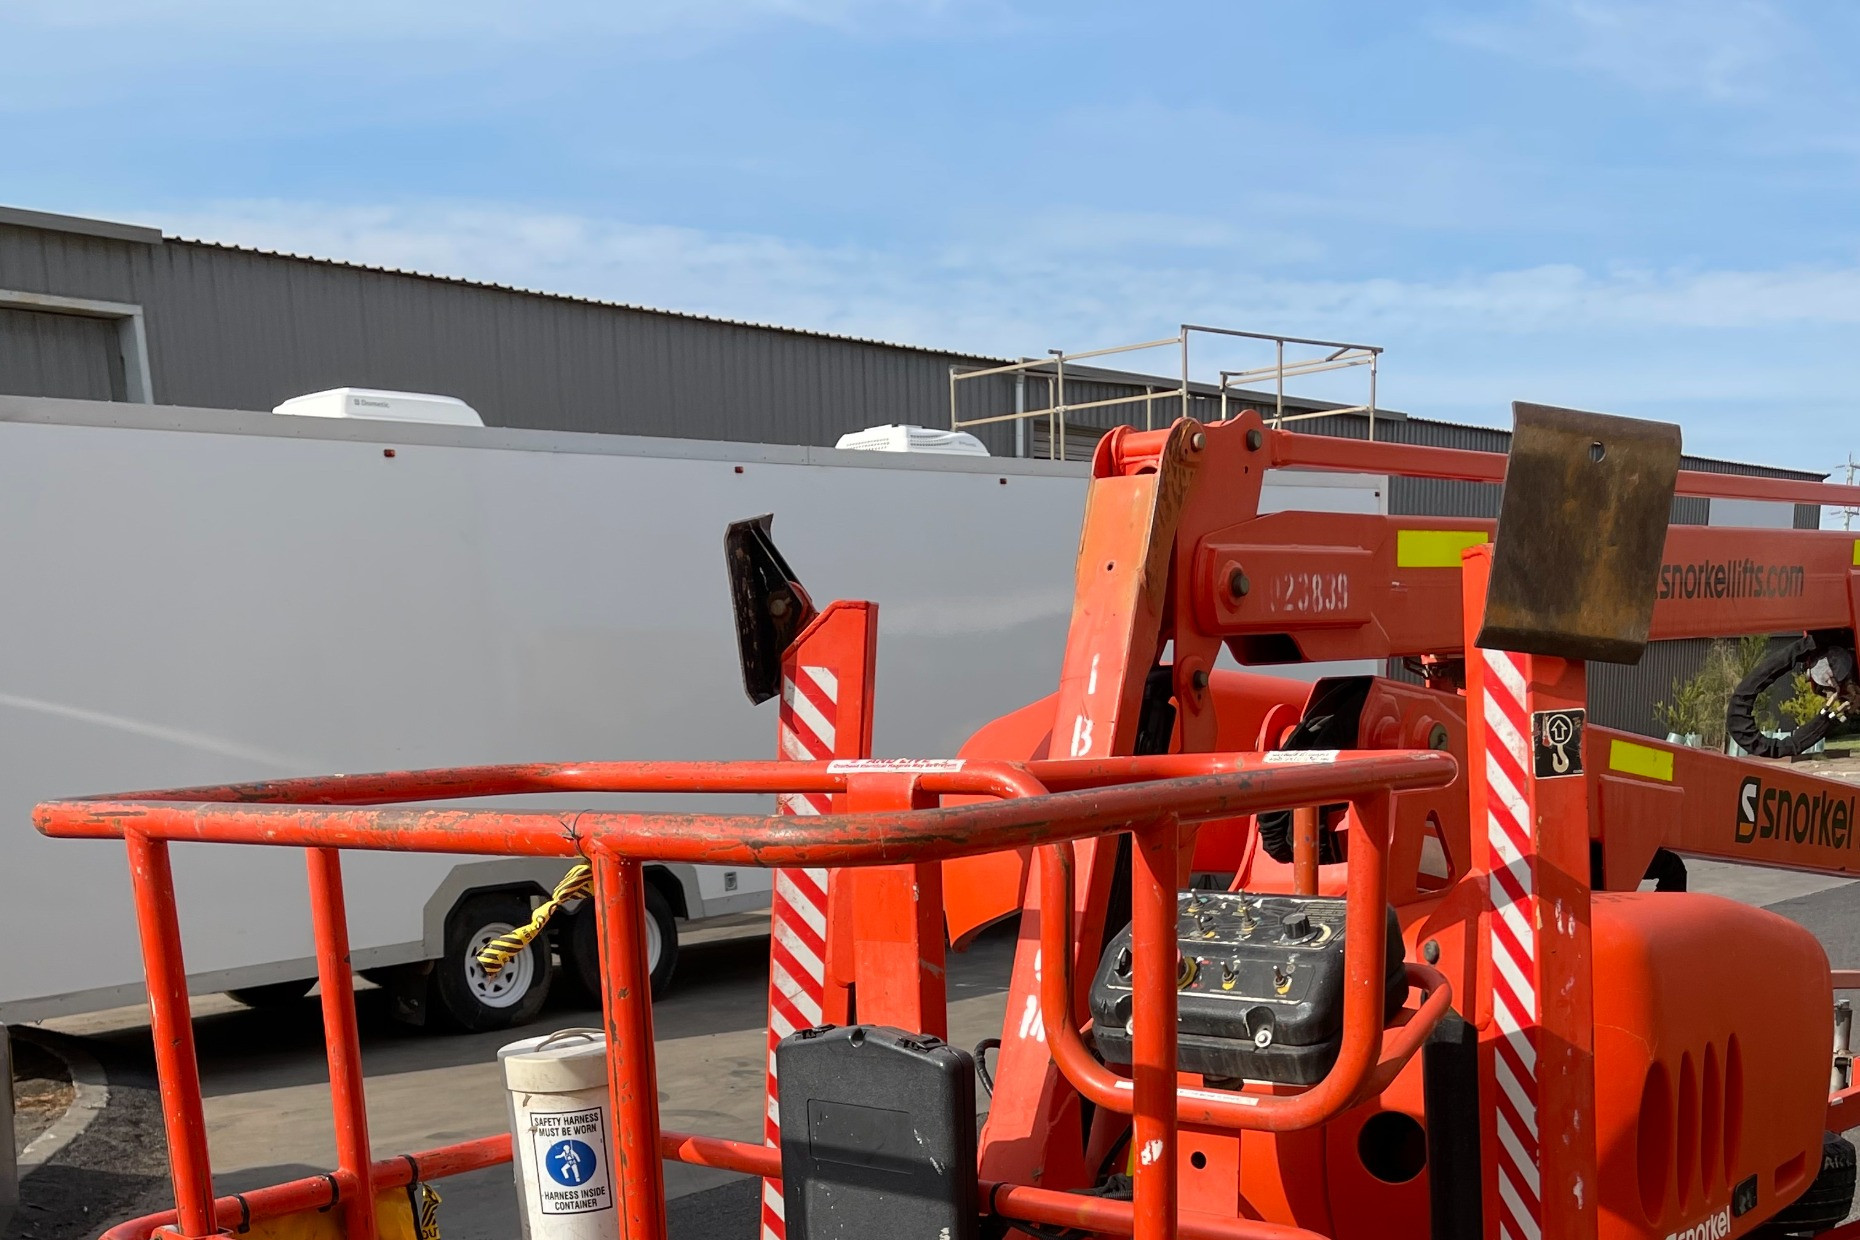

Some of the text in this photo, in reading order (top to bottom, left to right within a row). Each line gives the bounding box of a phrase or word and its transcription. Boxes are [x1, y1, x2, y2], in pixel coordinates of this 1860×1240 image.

[1760, 788, 1855, 849] snorkel
[534, 1113, 599, 1126] SAFETY HARNESS
[538, 1123, 597, 1137] MUST BE WORN
[544, 1186, 606, 1200] HARNESS INSIDE
[554, 1199, 598, 1211] CONTAINER
